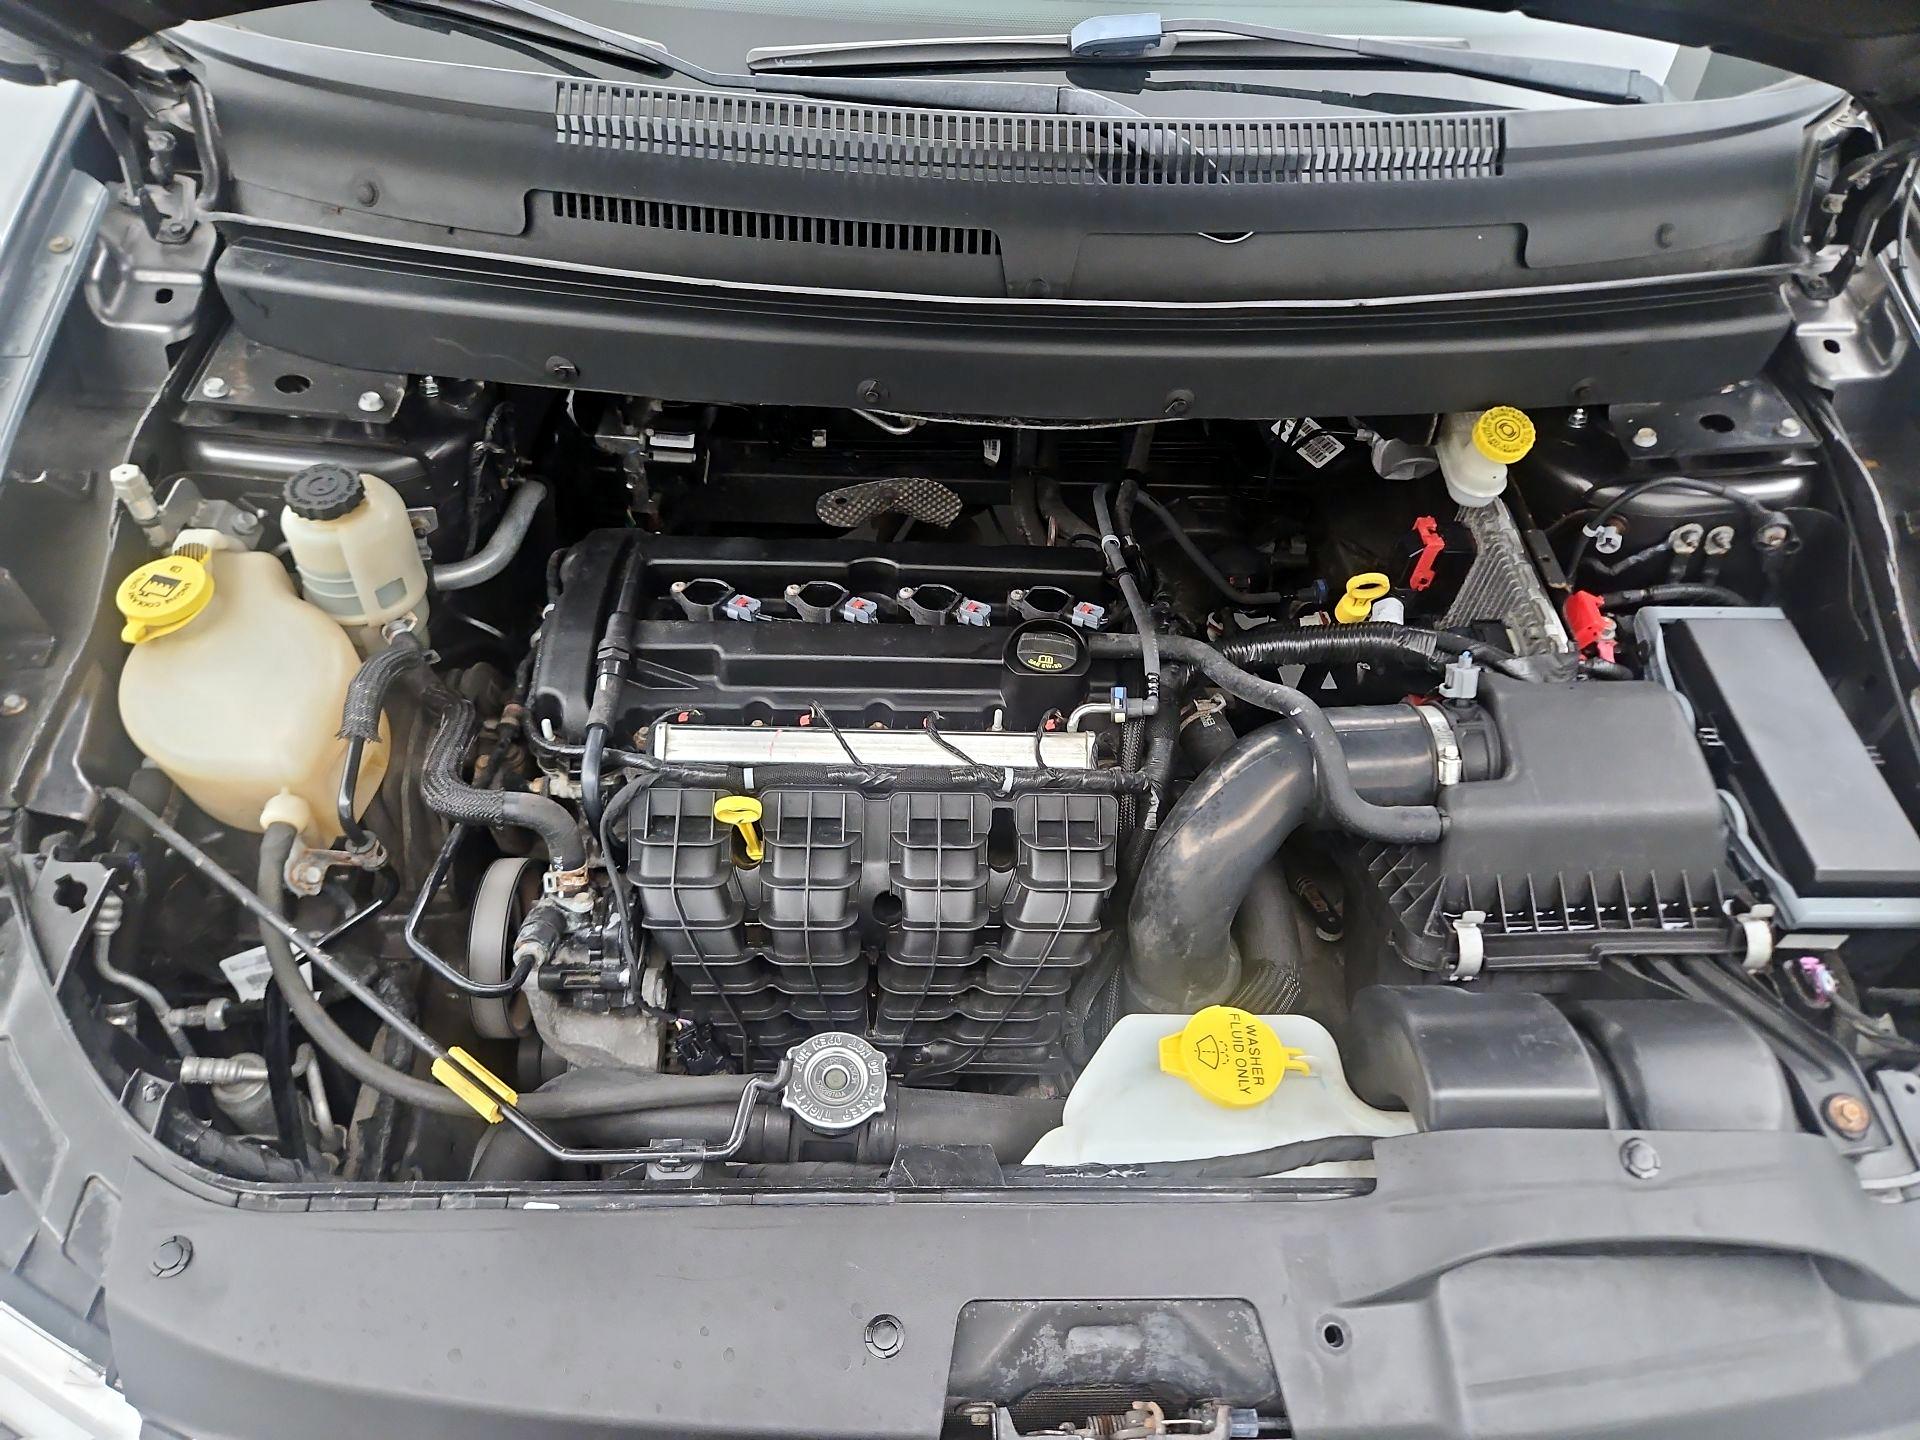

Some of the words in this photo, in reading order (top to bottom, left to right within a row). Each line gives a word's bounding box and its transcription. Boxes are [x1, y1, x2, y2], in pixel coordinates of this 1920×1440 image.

[812, 1035, 842, 1051] OPEN
[1229, 1013, 1245, 1053] FLUID
[793, 1048, 811, 1073] HOT
[847, 1039, 872, 1059] NOT
[1246, 1024, 1265, 1086] WASHER
[868, 1060, 881, 1075] DO
[1235, 1058, 1252, 1095] ONLY
[794, 1094, 832, 1122] TIGHT
[842, 1095, 875, 1120] KEEP
